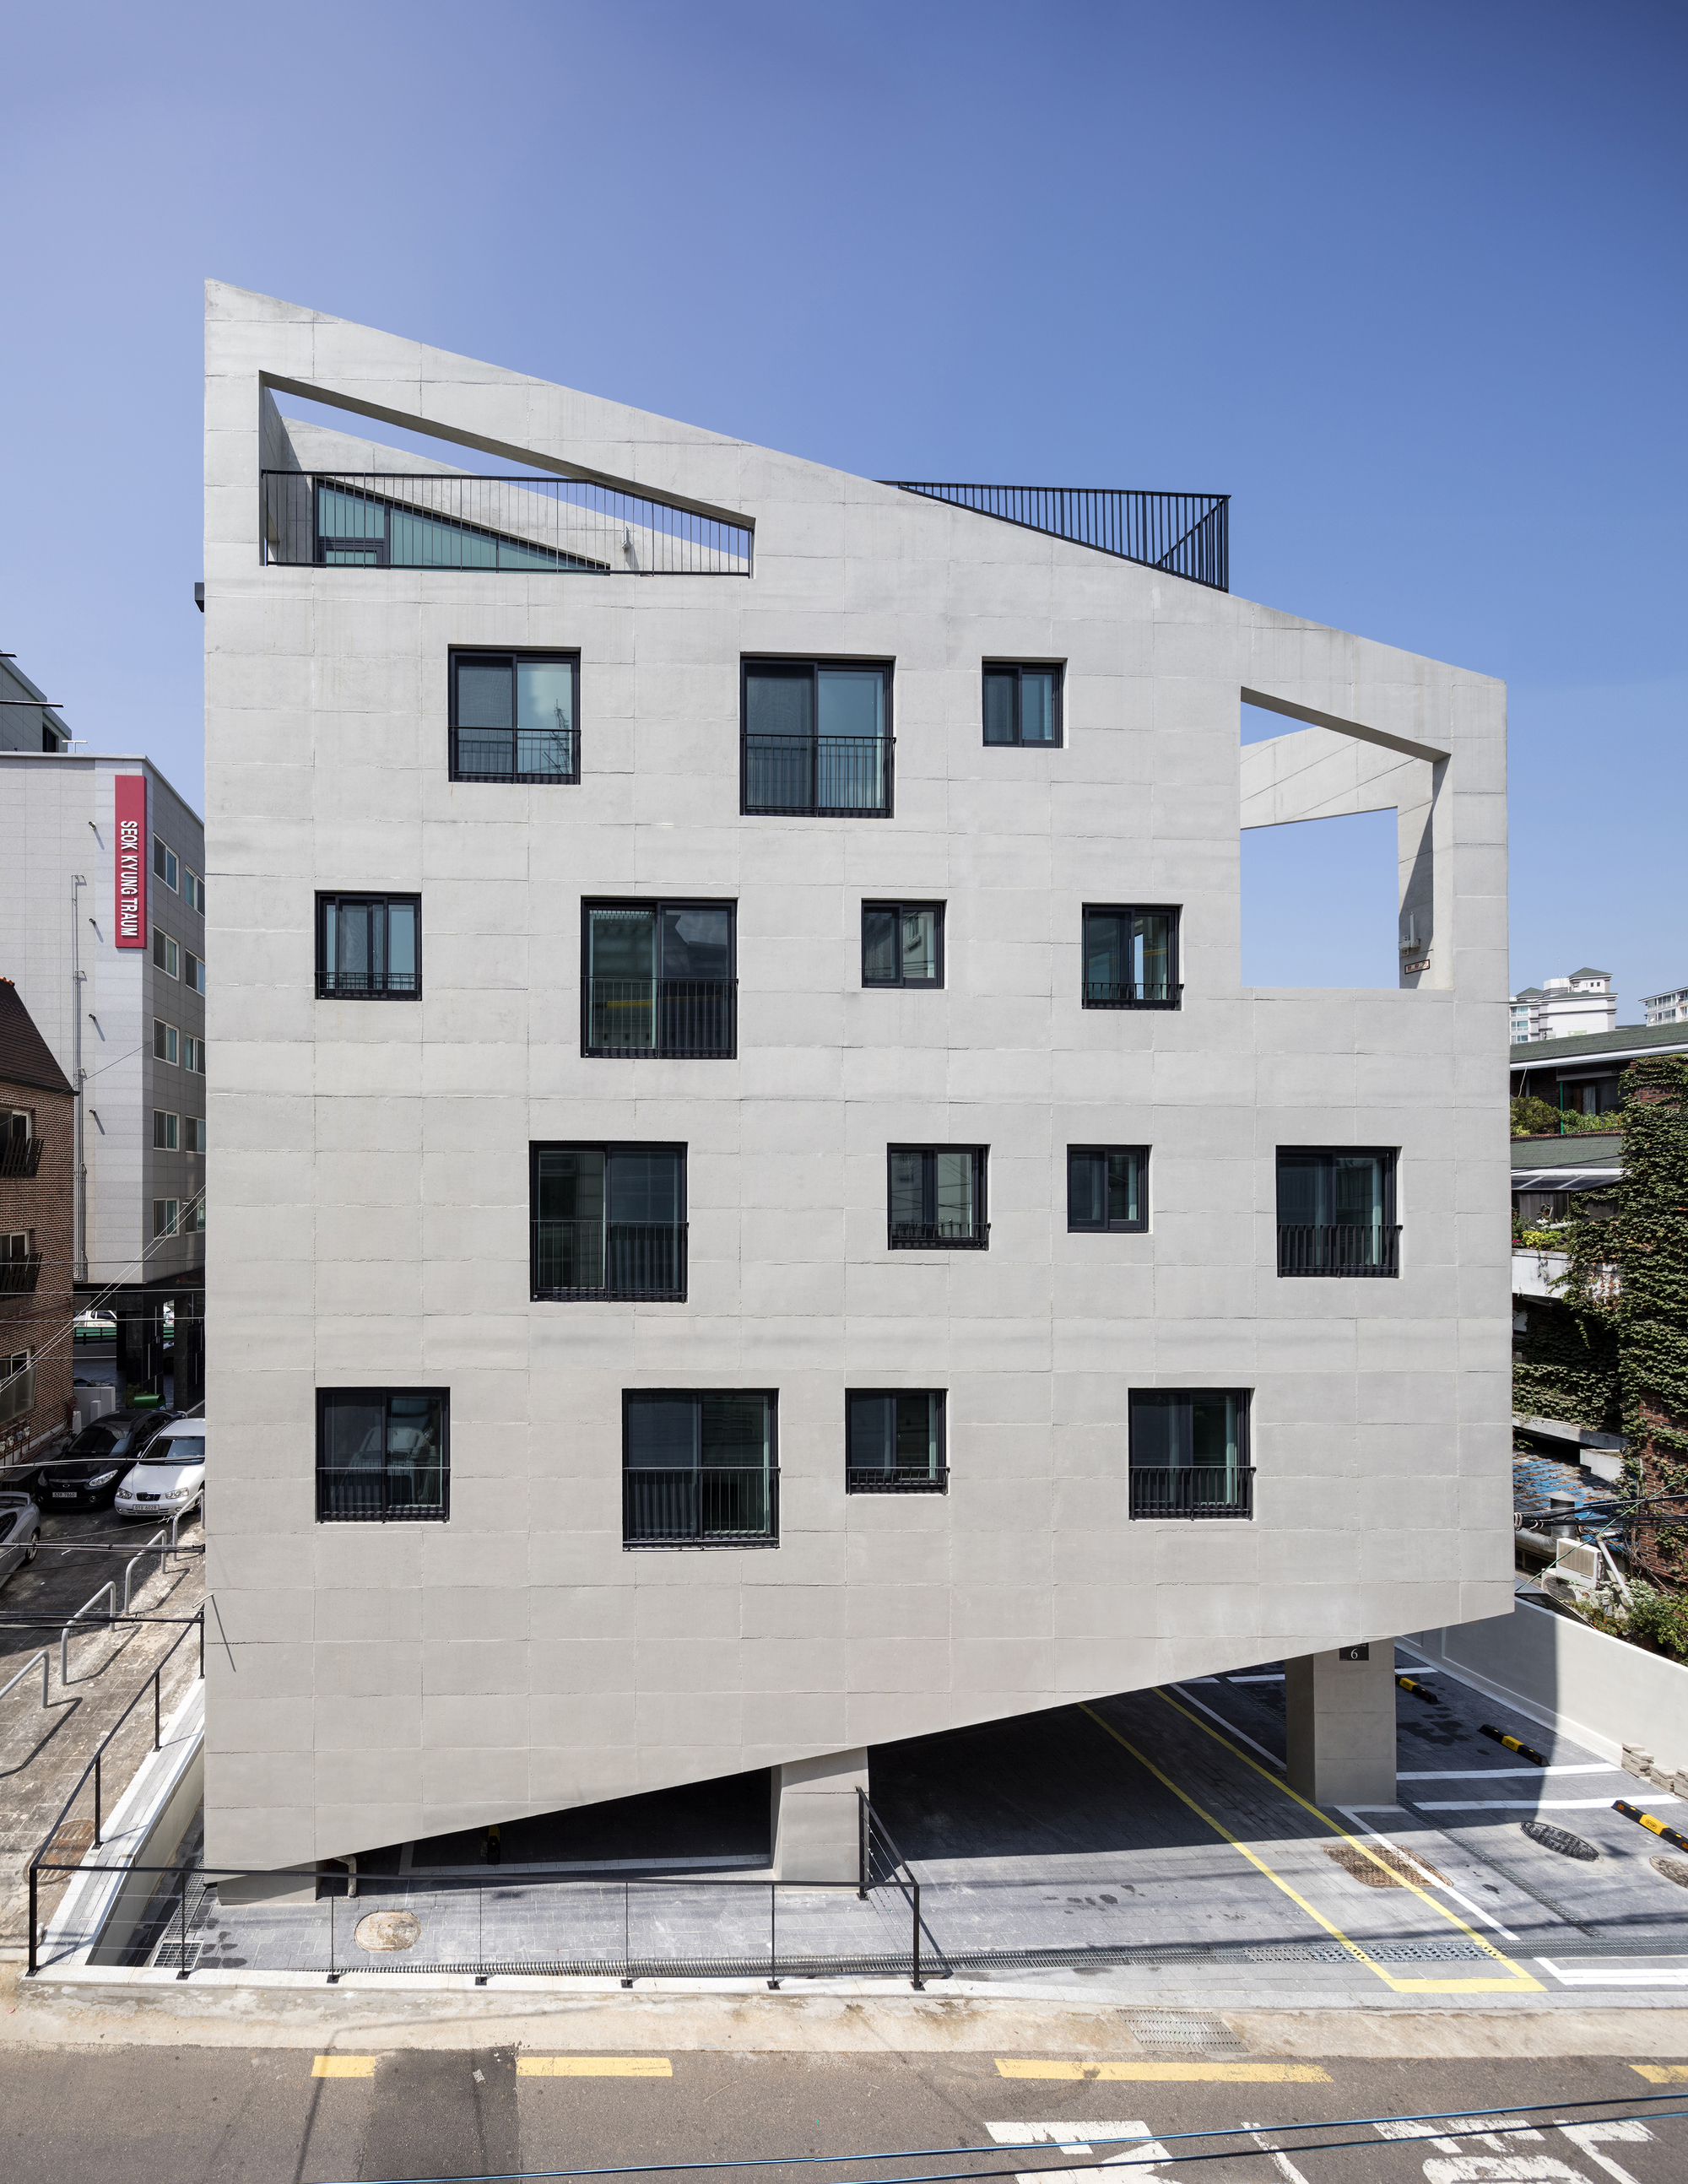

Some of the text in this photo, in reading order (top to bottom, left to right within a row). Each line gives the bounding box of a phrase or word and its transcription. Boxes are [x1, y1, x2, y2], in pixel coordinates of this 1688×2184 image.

[120, 820, 138, 937] SEOK KYUNG TRAUM
[1350, 1648, 1358, 1660] 6
